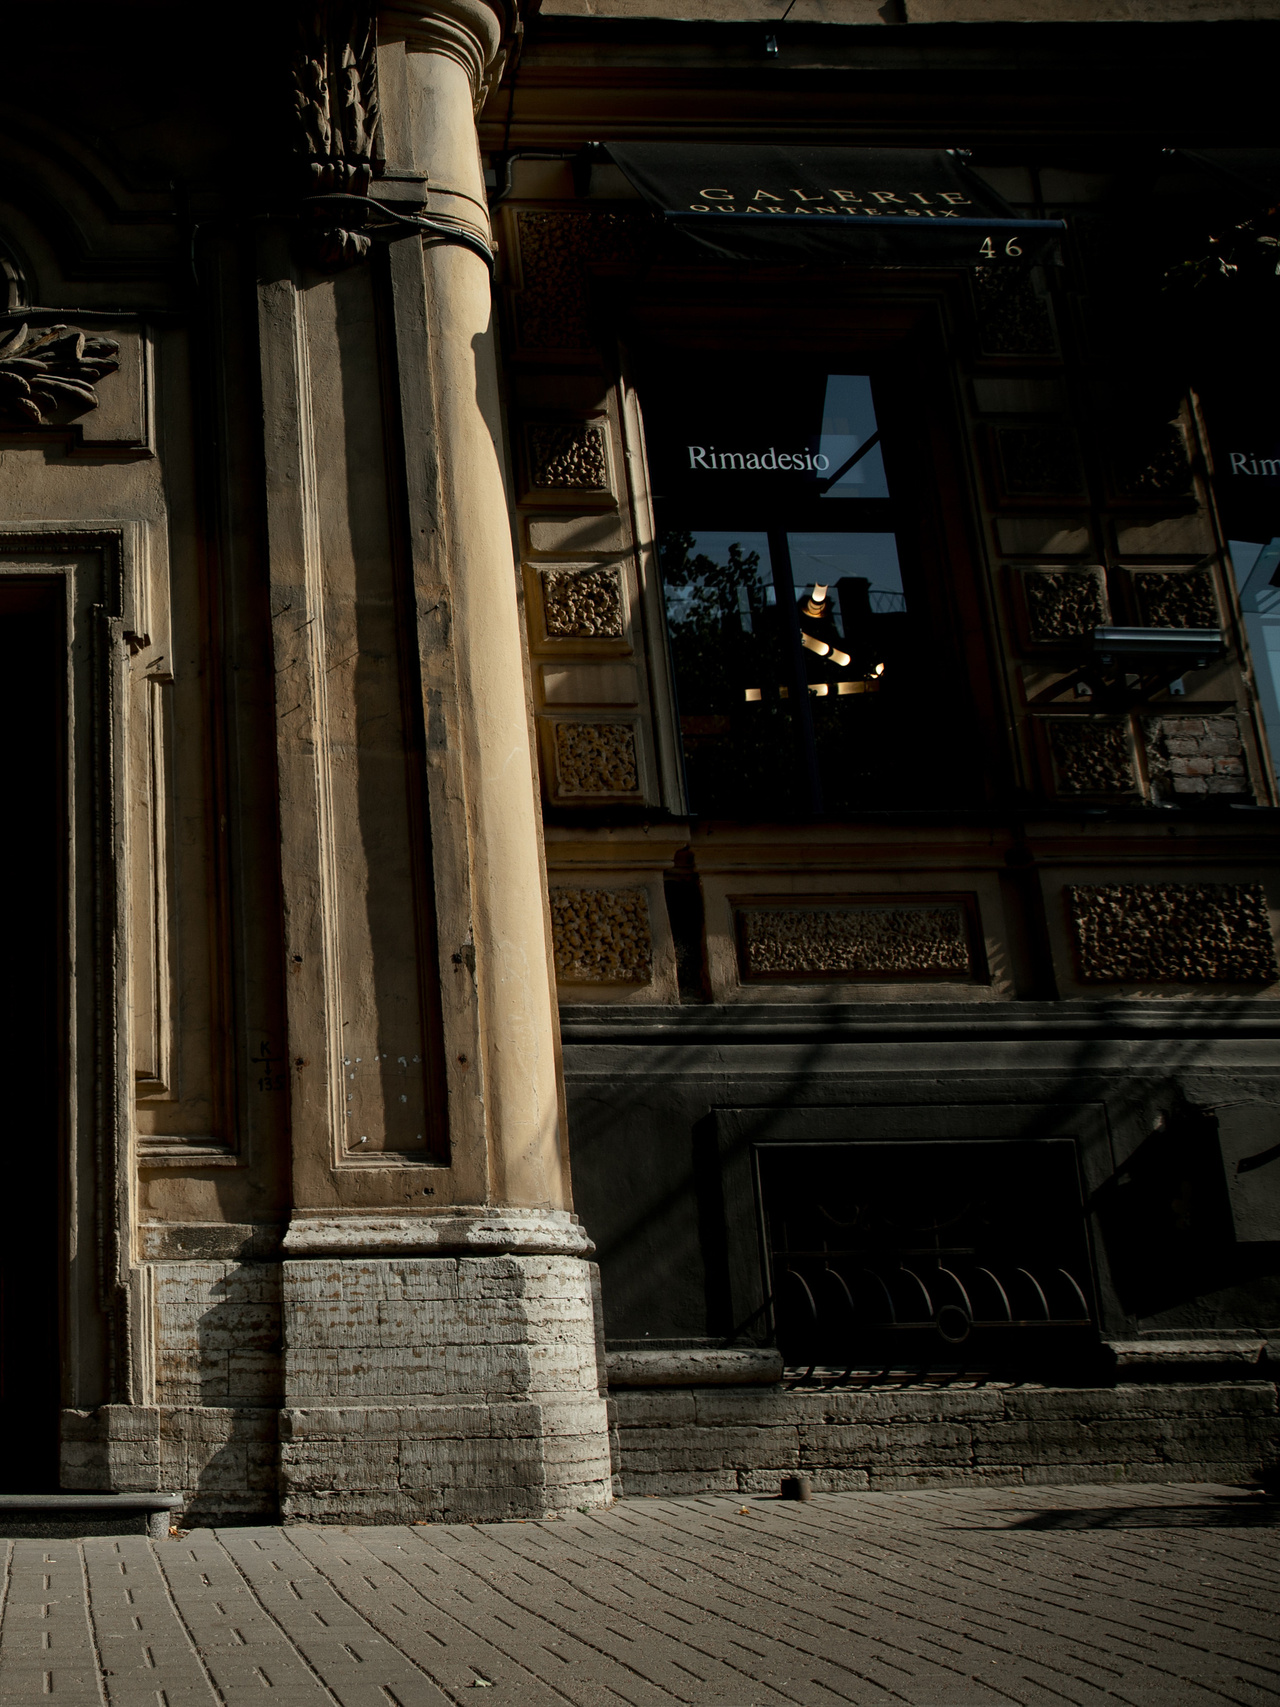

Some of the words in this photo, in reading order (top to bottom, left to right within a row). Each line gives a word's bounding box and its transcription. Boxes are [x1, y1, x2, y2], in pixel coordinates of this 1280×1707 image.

[699, 188, 973, 206] GALERIE
[689, 203, 961, 218] QUARANTE-SIX
[978, 236, 1023, 259] 46
[687, 445, 830, 471] Rimadesio
